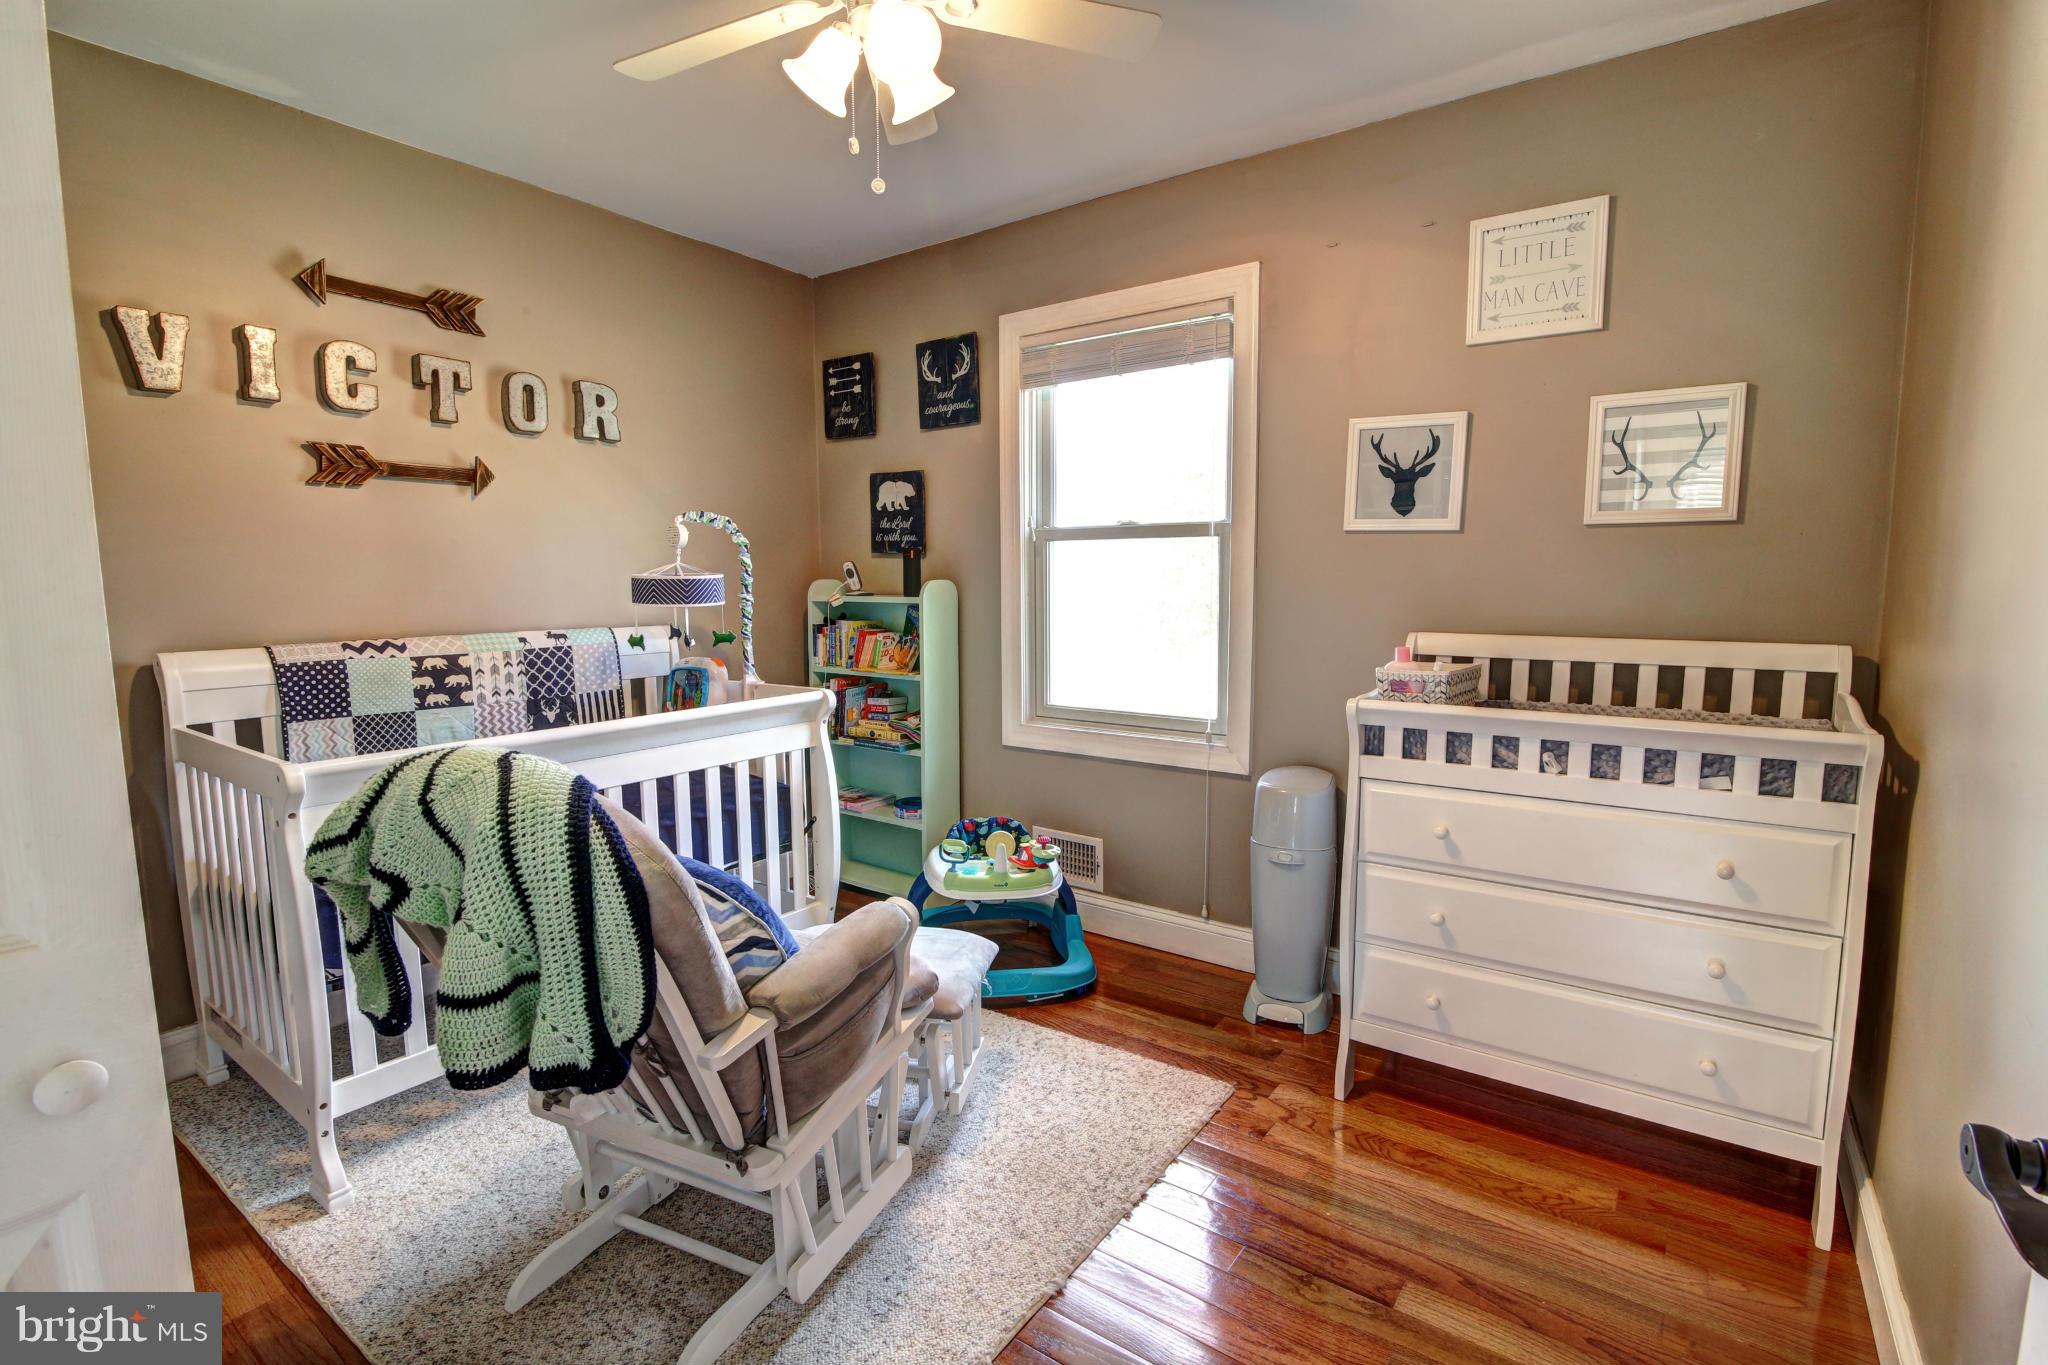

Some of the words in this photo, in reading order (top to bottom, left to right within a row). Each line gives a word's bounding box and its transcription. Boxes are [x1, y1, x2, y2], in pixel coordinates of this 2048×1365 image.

[1499, 236, 1577, 268] LITTLE
[1483, 285, 1525, 311] MAN
[1534, 275, 1586, 303] CAVE
[114, 304, 621, 443] VICTOR
[936, 383, 958, 400] and
[841, 400, 852, 413] be
[834, 416, 860, 431] strong
[879, 516, 892, 529] the
[892, 515, 914, 530] Lord
[875, 532, 883, 542] is
[883, 529, 901, 542] with
